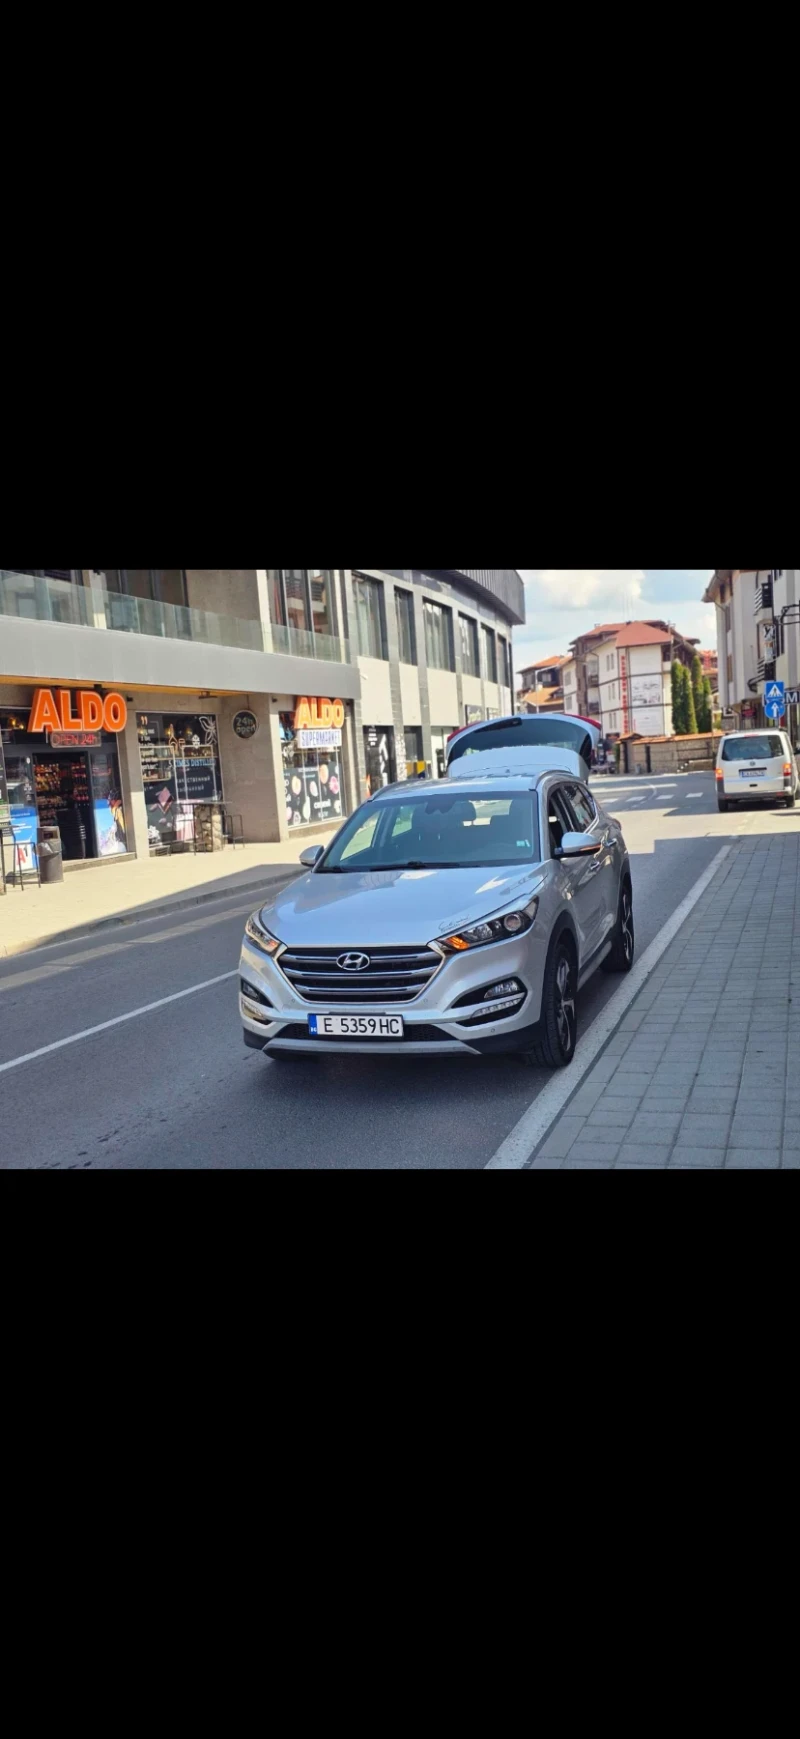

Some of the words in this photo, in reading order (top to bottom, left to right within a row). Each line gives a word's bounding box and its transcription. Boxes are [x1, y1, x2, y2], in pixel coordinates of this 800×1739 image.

[27, 688, 127, 732] ALDO
[294, 696, 344, 729] ALDO
[52, 733, 79, 746] OPEN
[301, 731, 340, 747] SUPERMARKET
[324, 1018, 333, 1032] E
